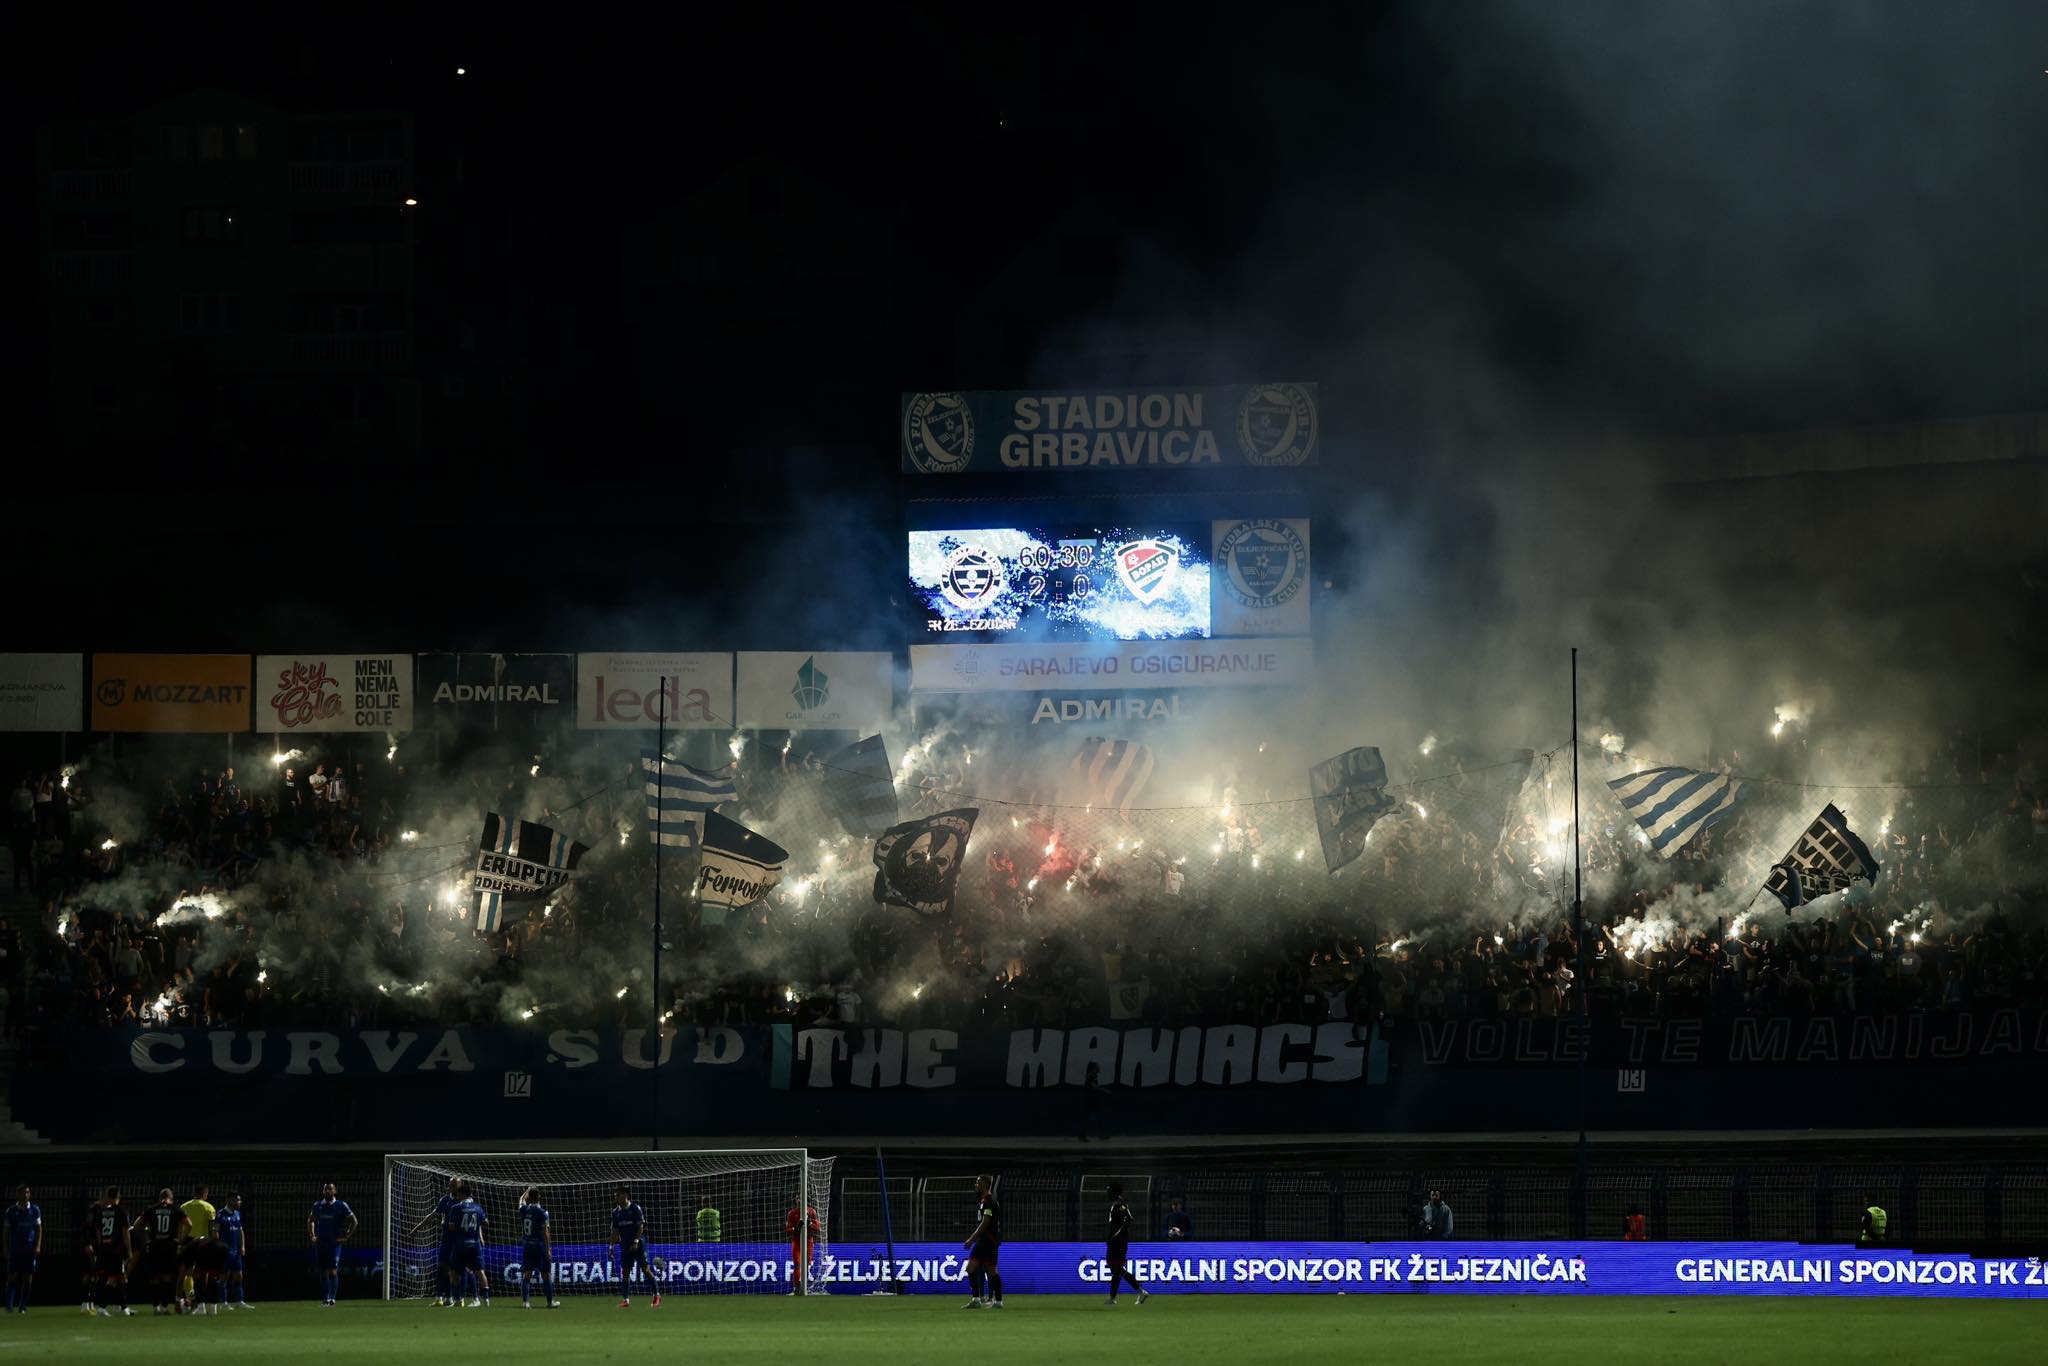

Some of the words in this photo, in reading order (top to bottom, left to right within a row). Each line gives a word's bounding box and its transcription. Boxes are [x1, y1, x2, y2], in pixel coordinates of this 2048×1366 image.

[1014, 394, 1203, 430] STADION
[1000, 431, 1222, 467] GRBAVICA
[355, 660, 393, 676] MENI
[1000, 656, 1119, 676] SARAJEVO
[1130, 653, 1276, 674] OSIGURANJE
[133, 684, 247, 706] MOZZART
[355, 677, 399, 692] NEMA
[432, 681, 560, 704] ADMIRAL
[355, 694, 401, 709] BOLJE
[595, 675, 716, 723] leda
[1031, 695, 1192, 725] ADMIRAL
[355, 711, 393, 726] COLE
[130, 1029, 475, 1075] CURVA
[546, 1026, 746, 1070] SUD
[1417, 1016, 1591, 1064] VOLE
[1618, 1016, 1704, 1061] TE
[797, 1027, 960, 1090] THE
[1007, 1021, 1368, 1089] MANIACS
[157, 1215, 170, 1233] 10
[460, 1213, 478, 1232] 44
[523, 1219, 532, 1236] 8
[1233, 1259, 1362, 1282] SPONZOR
[1370, 1259, 1402, 1281] FK
[1407, 1254, 1587, 1282] ŽELJEZNIČAR
[1674, 1258, 1832, 1283] GENERALNI
[1838, 1259, 1976, 1284] SPONZOR
[1984, 1261, 2020, 1285] FK
